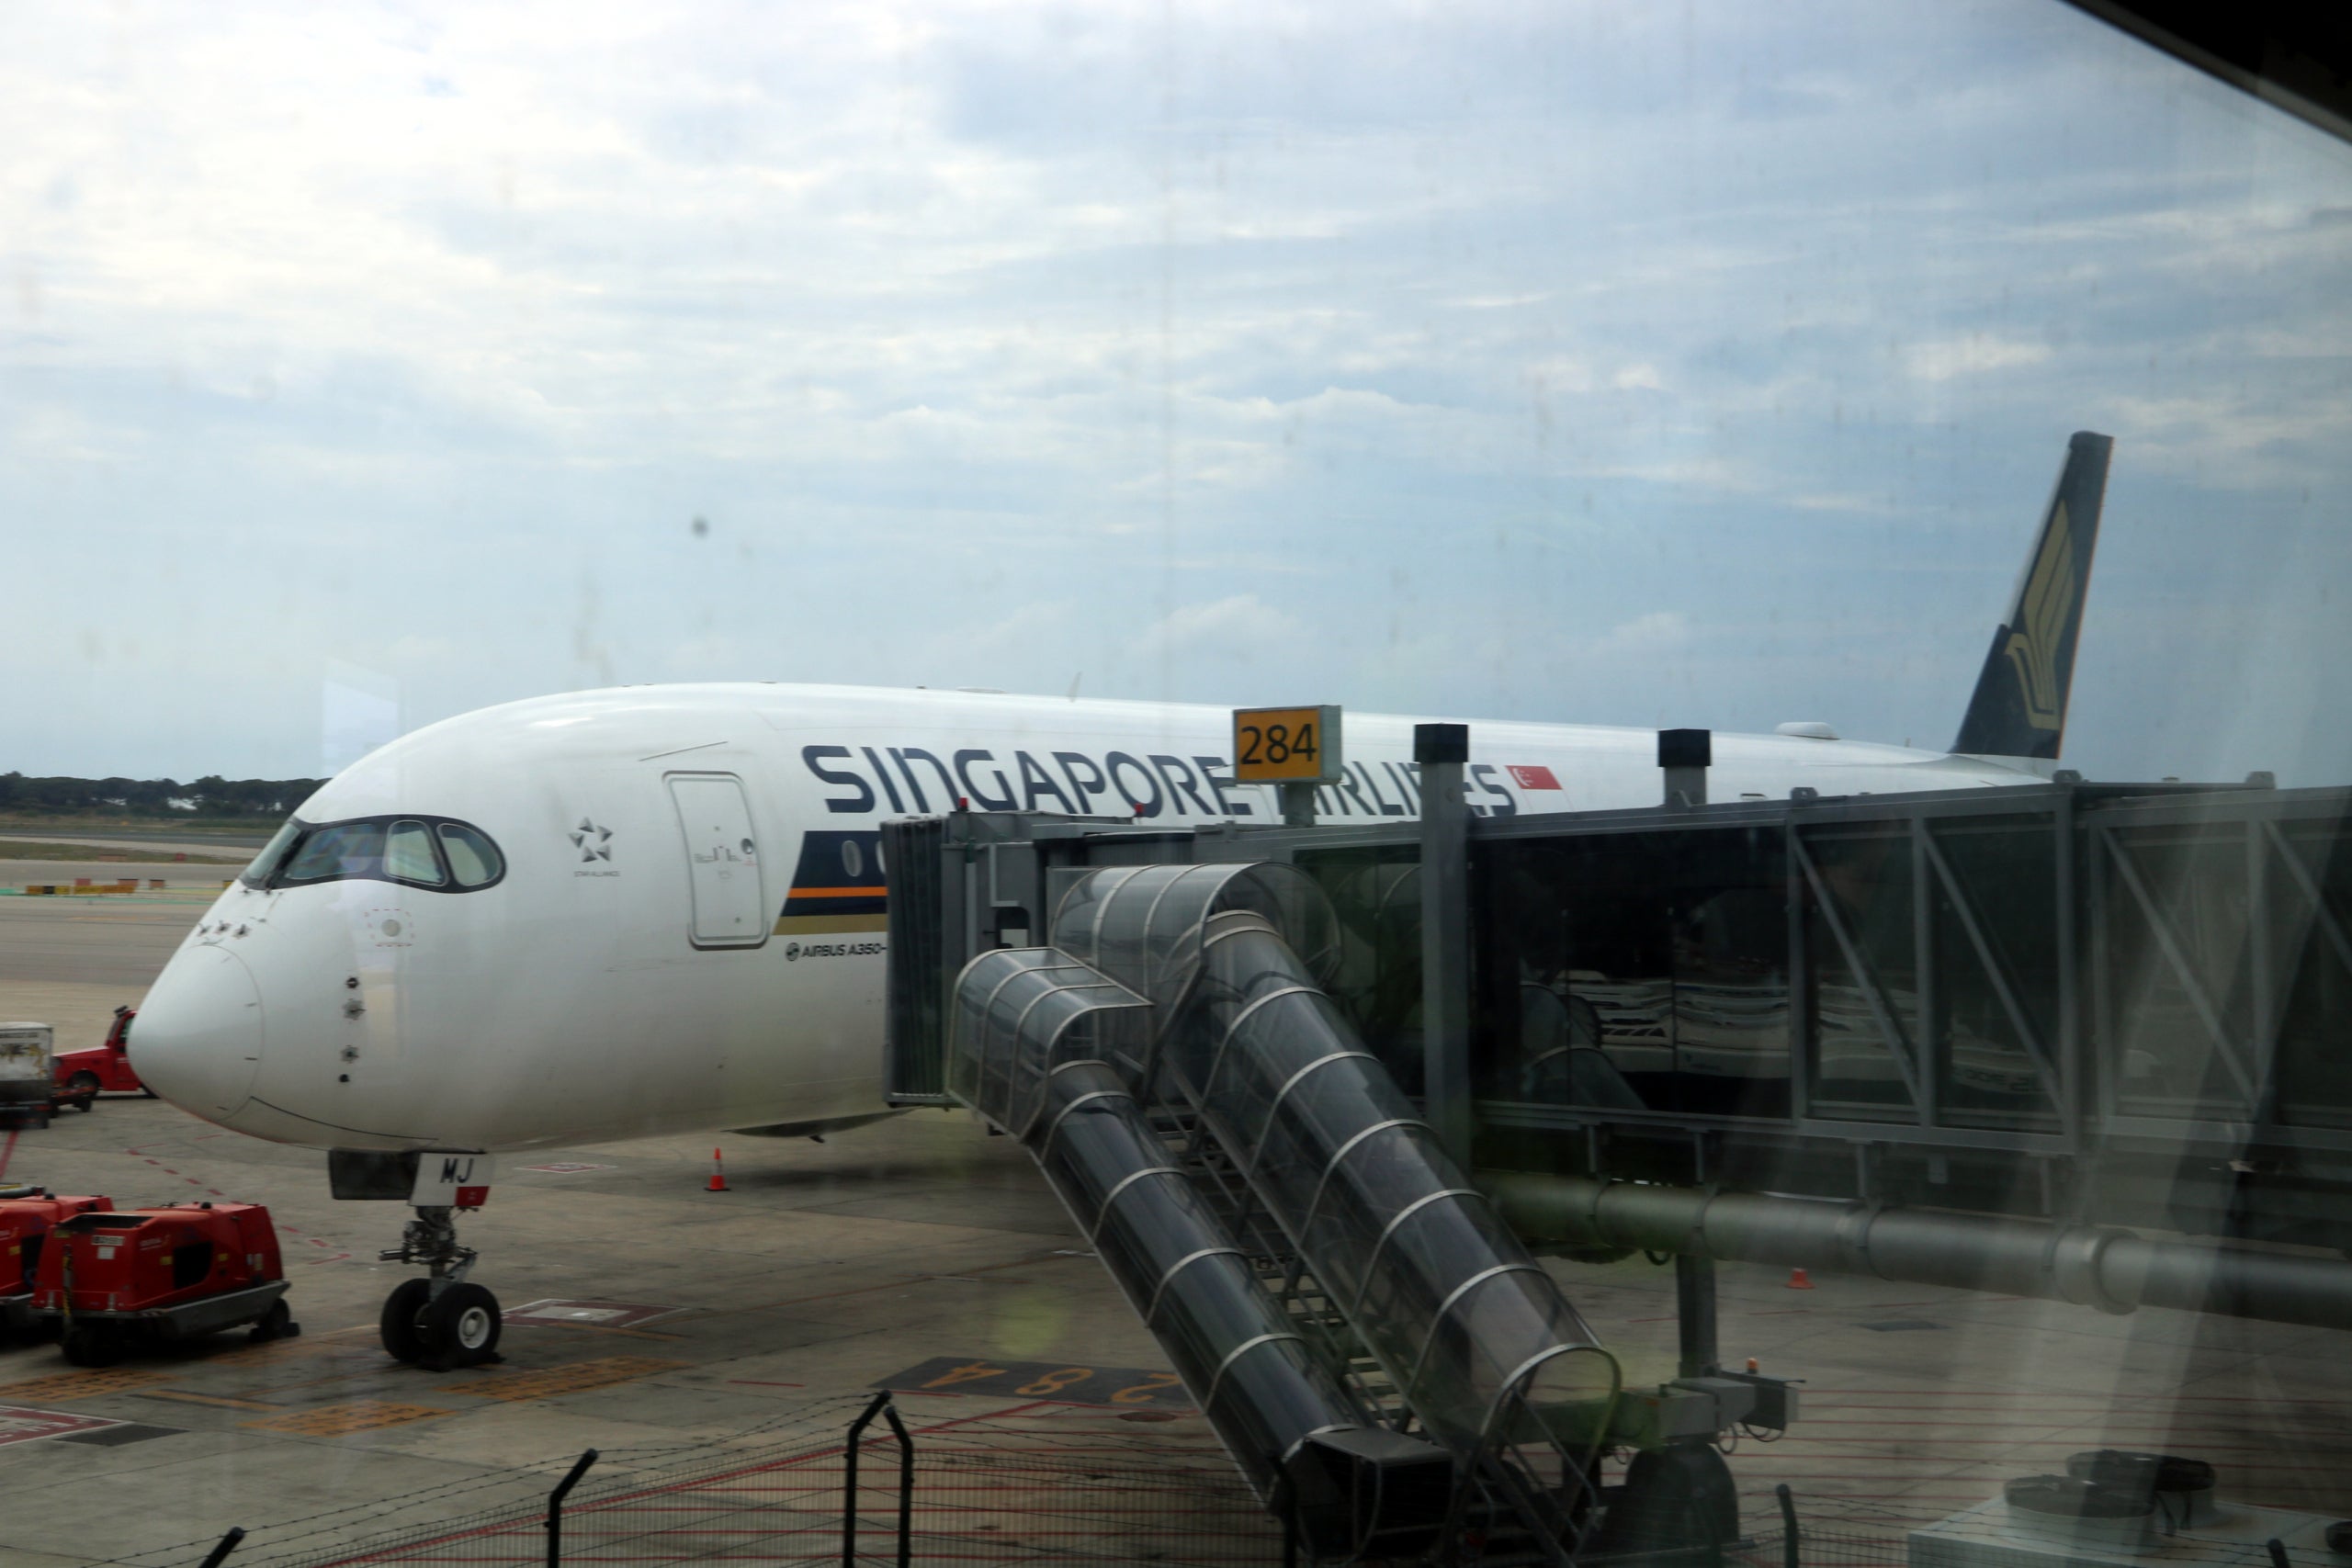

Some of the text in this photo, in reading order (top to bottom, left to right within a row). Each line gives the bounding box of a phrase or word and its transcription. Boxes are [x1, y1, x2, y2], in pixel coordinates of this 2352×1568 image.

[1240, 723, 1317, 764] 284
[801, 745, 1517, 818] SINGAPORE IRLIS
[801, 944, 845, 957] AIRBUS
[440, 1157, 474, 1183] MJ
[921, 1361, 1182, 1404] 284
